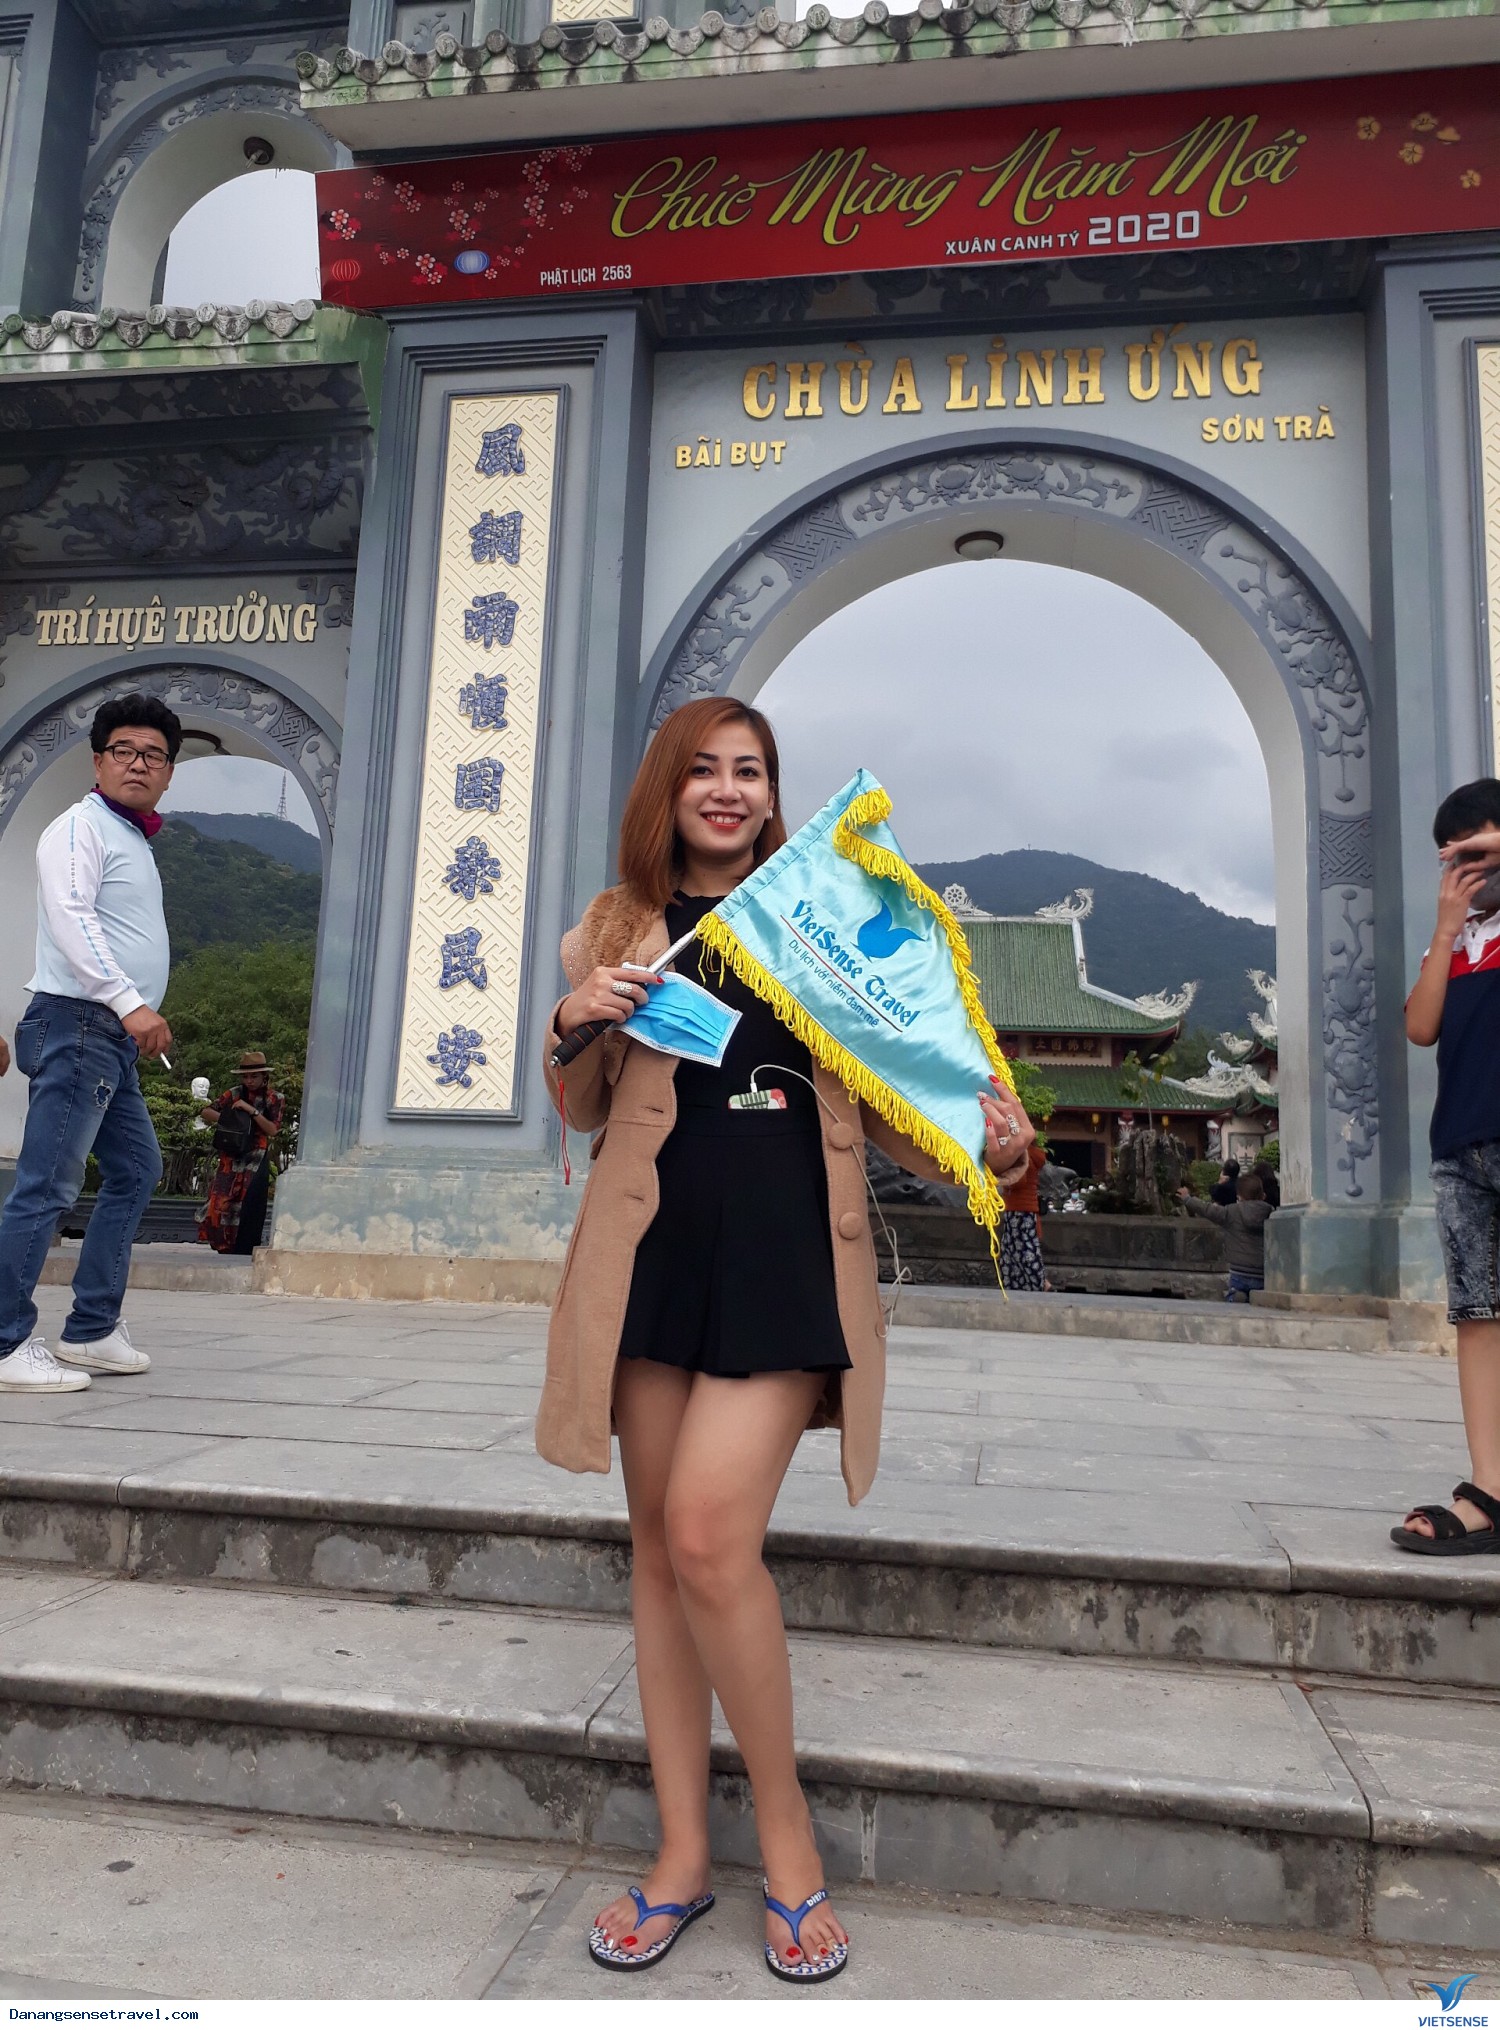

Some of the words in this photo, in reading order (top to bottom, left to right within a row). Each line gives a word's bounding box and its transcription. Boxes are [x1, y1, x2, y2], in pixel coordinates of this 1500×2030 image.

[611, 156, 757, 239] Chúc
[750, 146, 963, 245] Mừng
[970, 126, 1134, 226] Năm
[1127, 113, 1307, 217] Mới
[945, 237, 996, 255] XUÂN
[1001, 235, 1053, 250] CANH
[1057, 230, 1080, 247] TÝ
[1088, 210, 1200, 245] 2020
[540, 267, 569, 288] PHẬT
[571, 267, 596, 286] LỊCH
[602, 264, 632, 281] 2563
[742, 341, 922, 420] CHÙA
[1124, 322, 1263, 401] ỨNG
[1202, 413, 1264, 443] SƠN
[1273, 405, 1335, 440] TRÀ
[730, 440, 787, 472] BỤT
[36, 594, 97, 646] TRÍ
[174, 590, 318, 644] TRƯỞNG
[789, 939, 802, 954] Du
[799, 950, 815, 968] lịch
[815, 964, 829, 981] với
[846, 996, 865, 1017] đam
[791, 899, 863, 979] VietSense
[864, 974, 921, 1027] Travel
